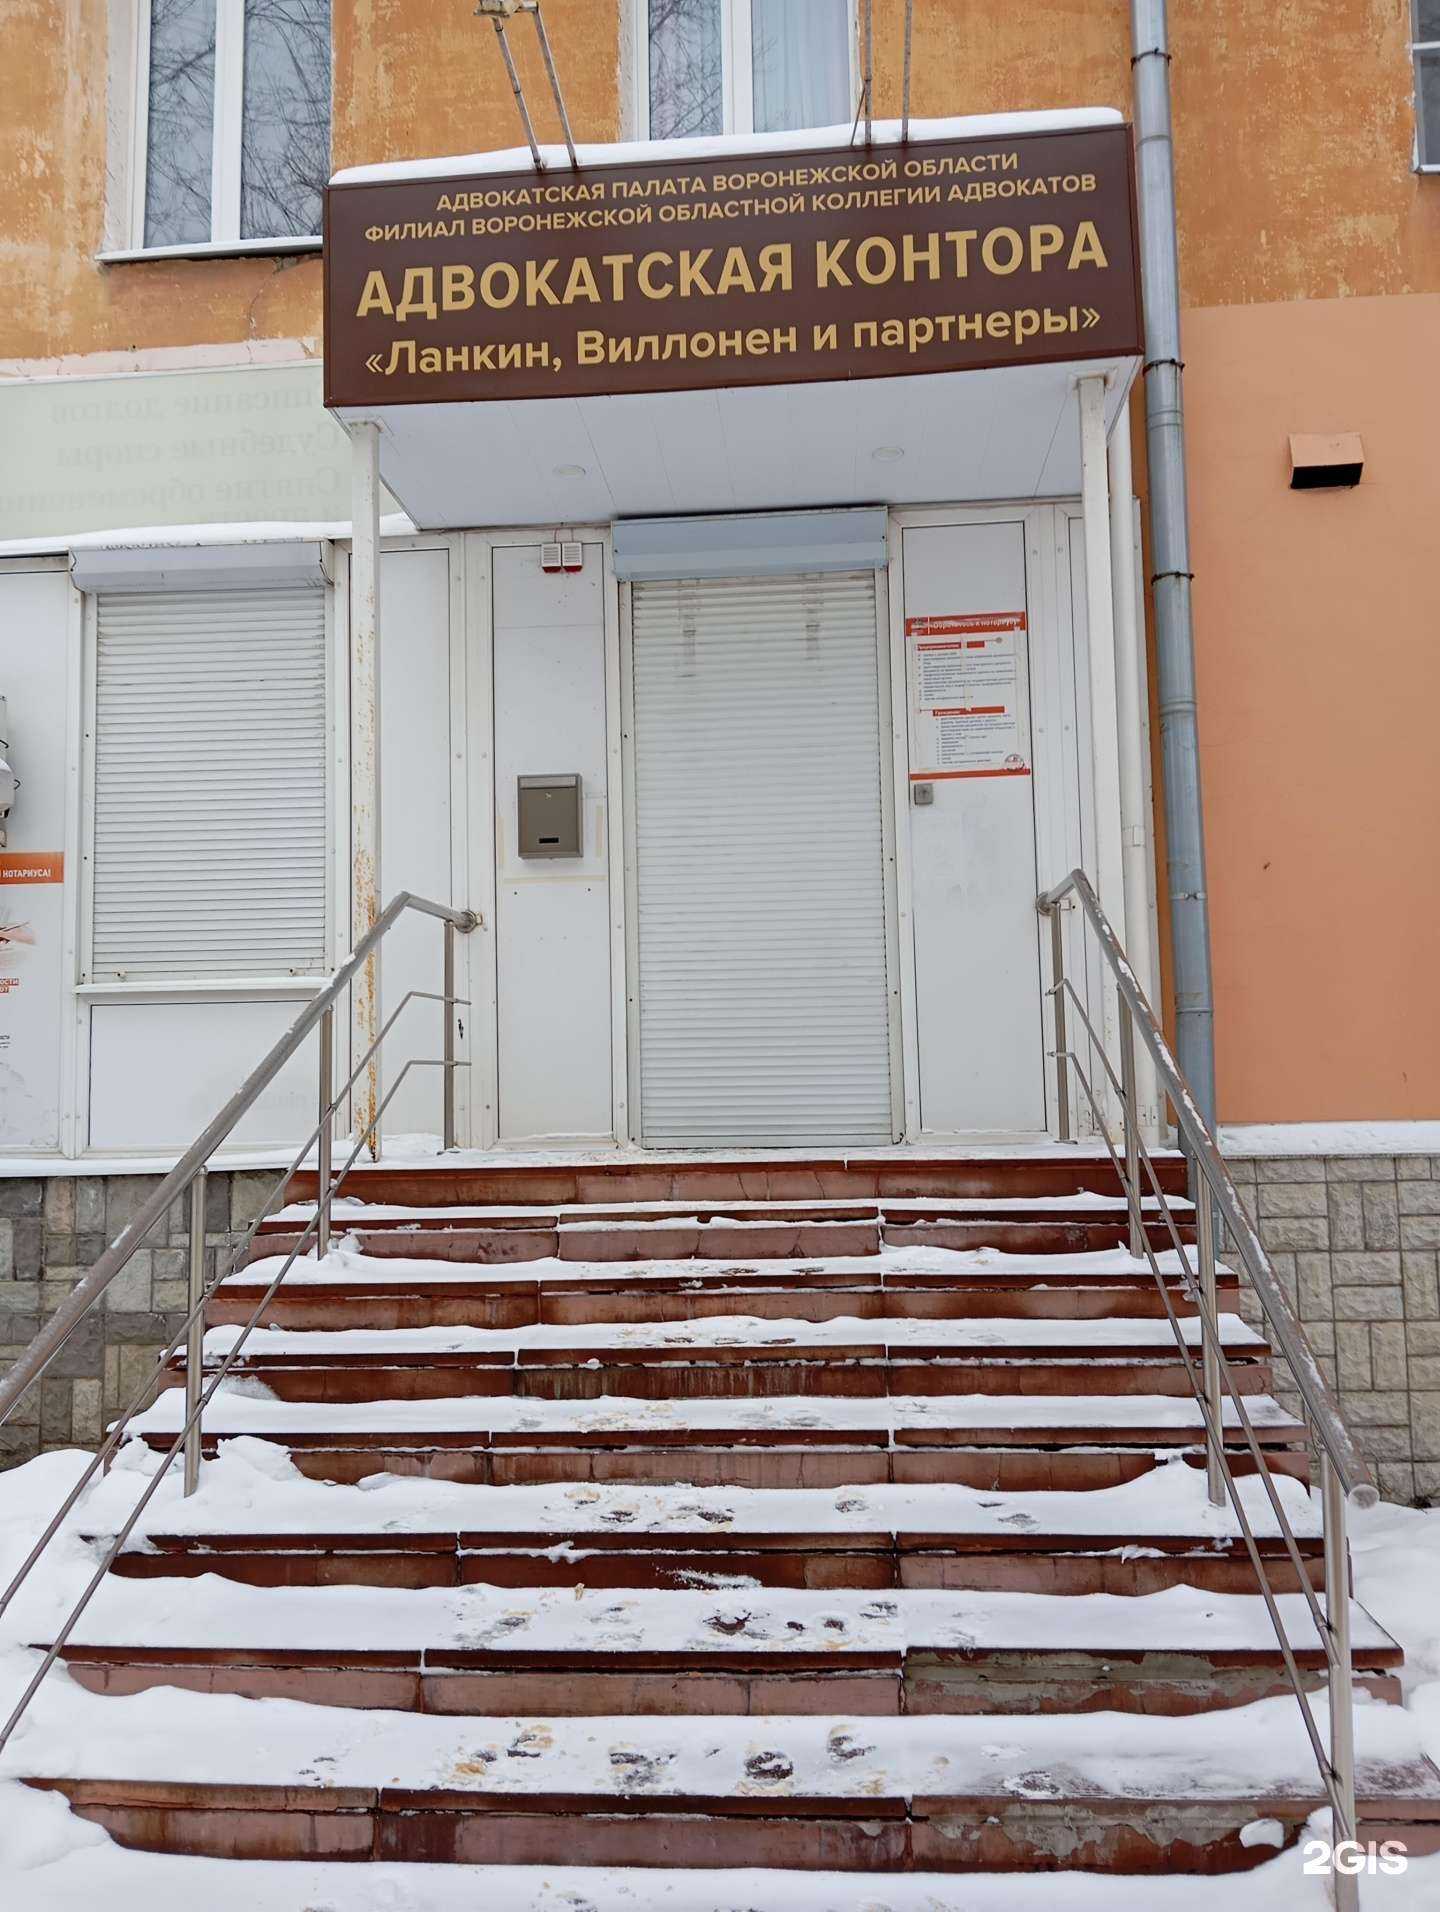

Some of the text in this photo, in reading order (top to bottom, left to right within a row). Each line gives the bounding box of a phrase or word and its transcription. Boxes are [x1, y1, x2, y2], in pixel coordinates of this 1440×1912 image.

[365, 174, 1097, 242] ФИЛИАЛ ВОРОНЕЖСКОЙ ОБЛАСТНОЙ КОЛЛЕГИИ АДВОКАТОВ
[437, 154, 1019, 213] АДВОКАТСКАЯ ПАЛАТА ВОРОНЕЖСКОЙ ОБЛАСТИ
[355, 221, 1109, 322] АДВОКАТСКАЯ КОНТОРА
[365, 306, 1101, 377] «Ланкин, Виллонен и партнеры»
